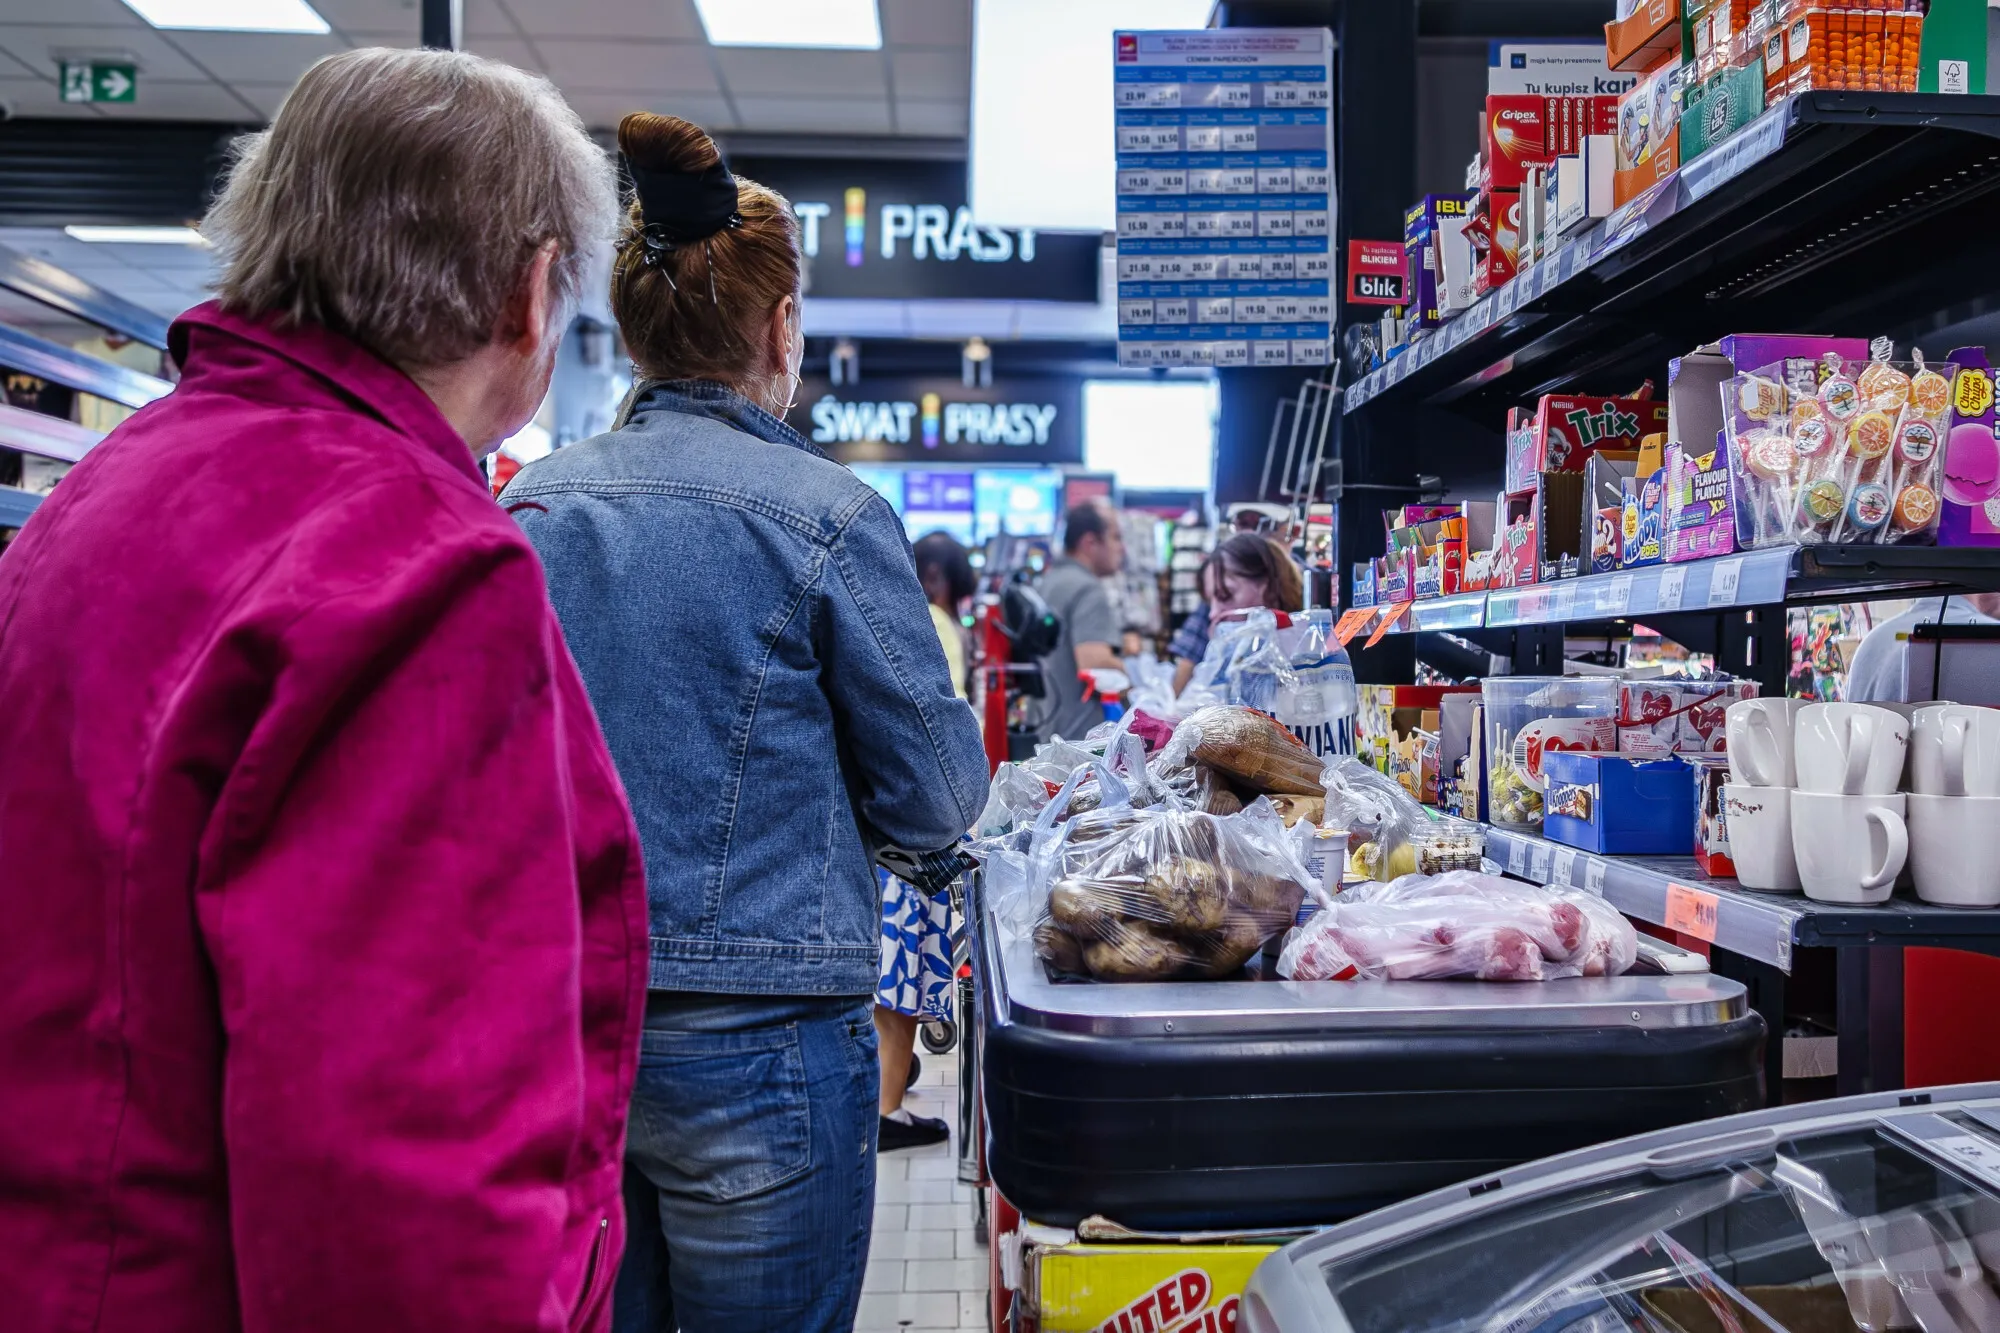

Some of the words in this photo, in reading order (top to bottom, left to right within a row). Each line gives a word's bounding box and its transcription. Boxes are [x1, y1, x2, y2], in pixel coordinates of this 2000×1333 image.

[1547, 57, 1563, 65] karty
[1525, 83, 1540, 93] Tu
[1544, 82, 1589, 96] kupisz
[1501, 109, 1536, 121] Gripex
[1714, 101, 1725, 115] tic
[1711, 113, 1725, 131] tac
[1361, 255, 1398, 265] BLIKIEM
[1360, 276, 1396, 296] blik
[1960, 375, 1971, 409] Chupa
[1970, 377, 1982, 411] Chups
[944, 403, 1057, 445] PRASY
[1565, 401, 1640, 448] Trix
[1695, 469, 1727, 487] FLAVOUR
[1695, 483, 1727, 501] PLAYLIST
[1709, 499, 1728, 516] XXL
[1641, 544, 1659, 559] POPS
[1541, 564, 1556, 577] Dare
[1388, 579, 1406, 592] mentos
[1415, 579, 1440, 595] mentos
[1642, 700, 1664, 717] Love
[1552, 787, 1577, 808] Knoppers
